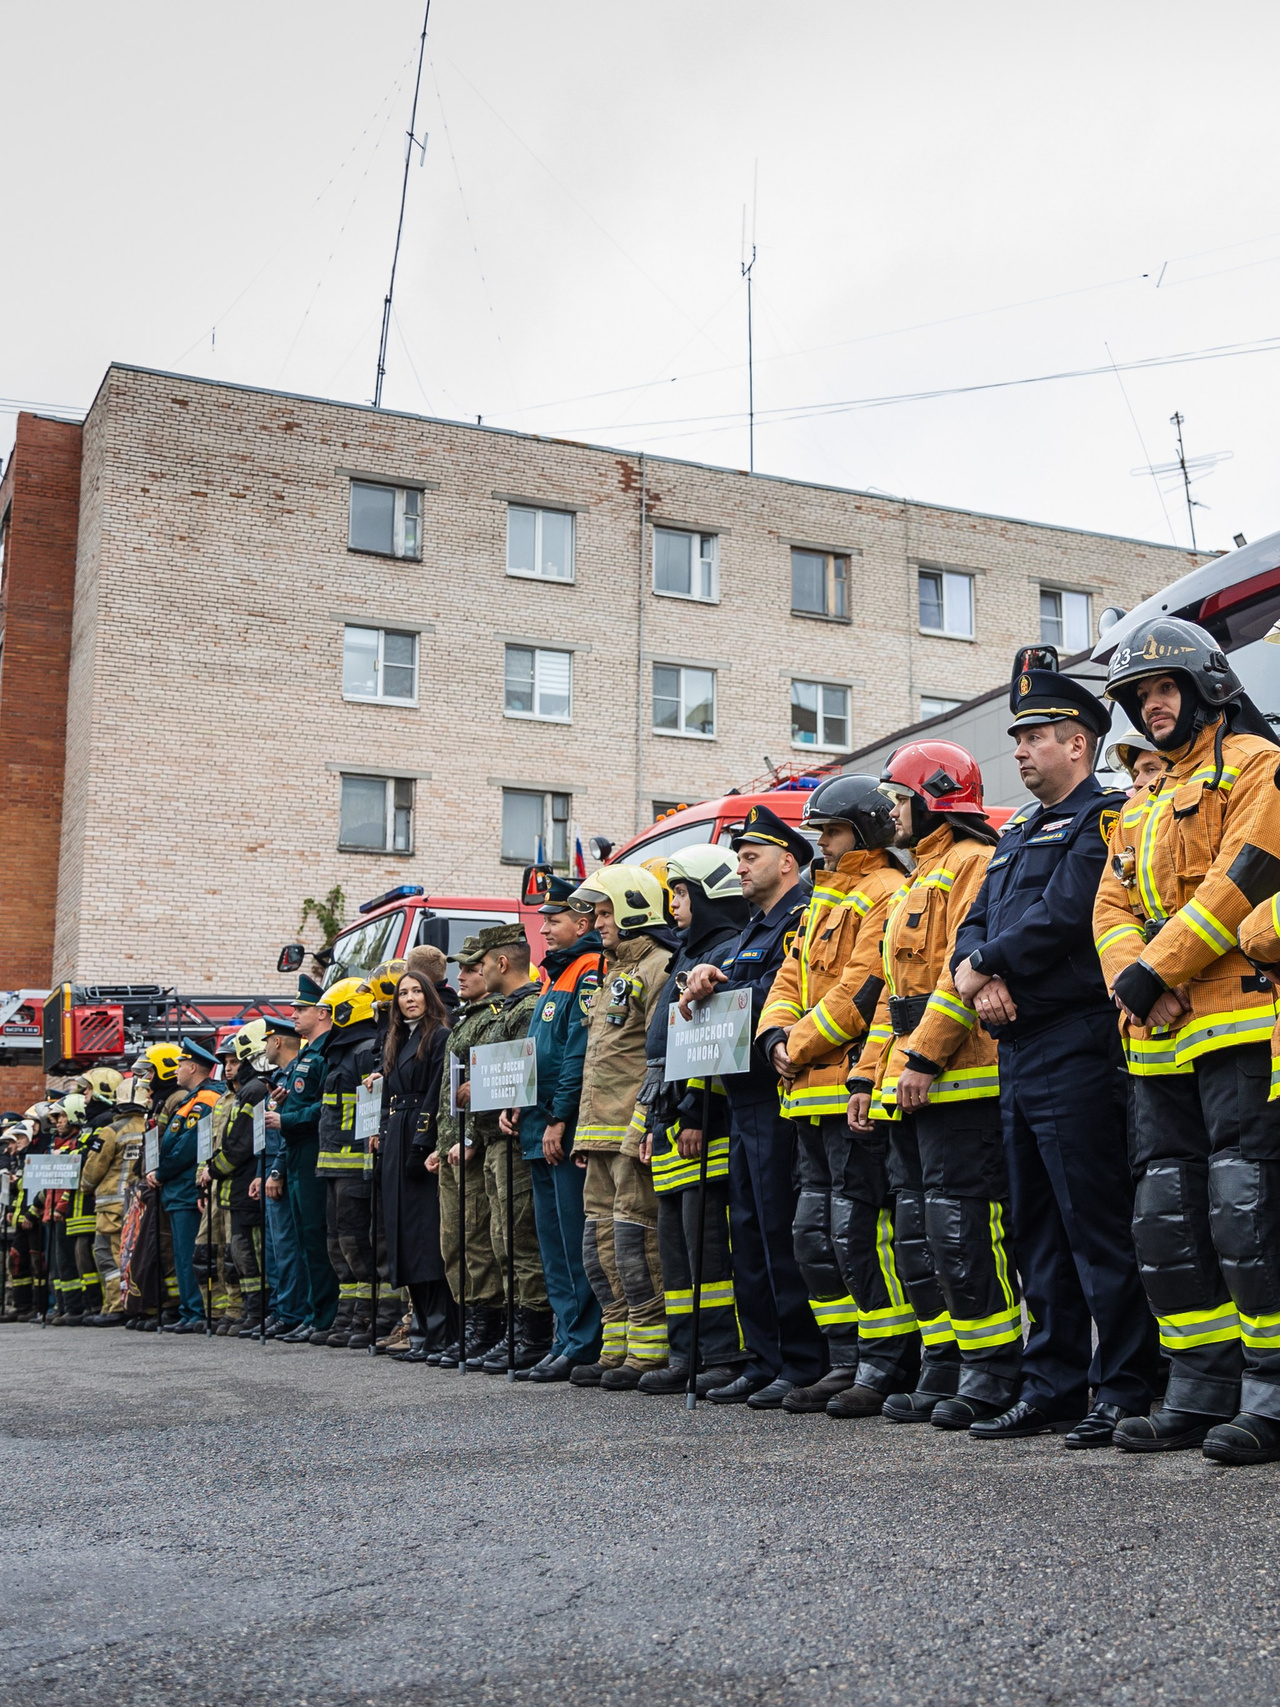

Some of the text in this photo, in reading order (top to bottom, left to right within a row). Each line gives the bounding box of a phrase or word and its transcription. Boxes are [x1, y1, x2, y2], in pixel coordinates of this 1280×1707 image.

[694, 1006, 711, 1025] ПСО
[674, 1022, 734, 1047] ПРИМОРСКОГО
[686, 1043, 720, 1063] РАЙОНА
[481, 1060, 525, 1076] ГУ МЧС РОССИИ
[490, 1086, 516, 1099] ОБЛАСТИ
